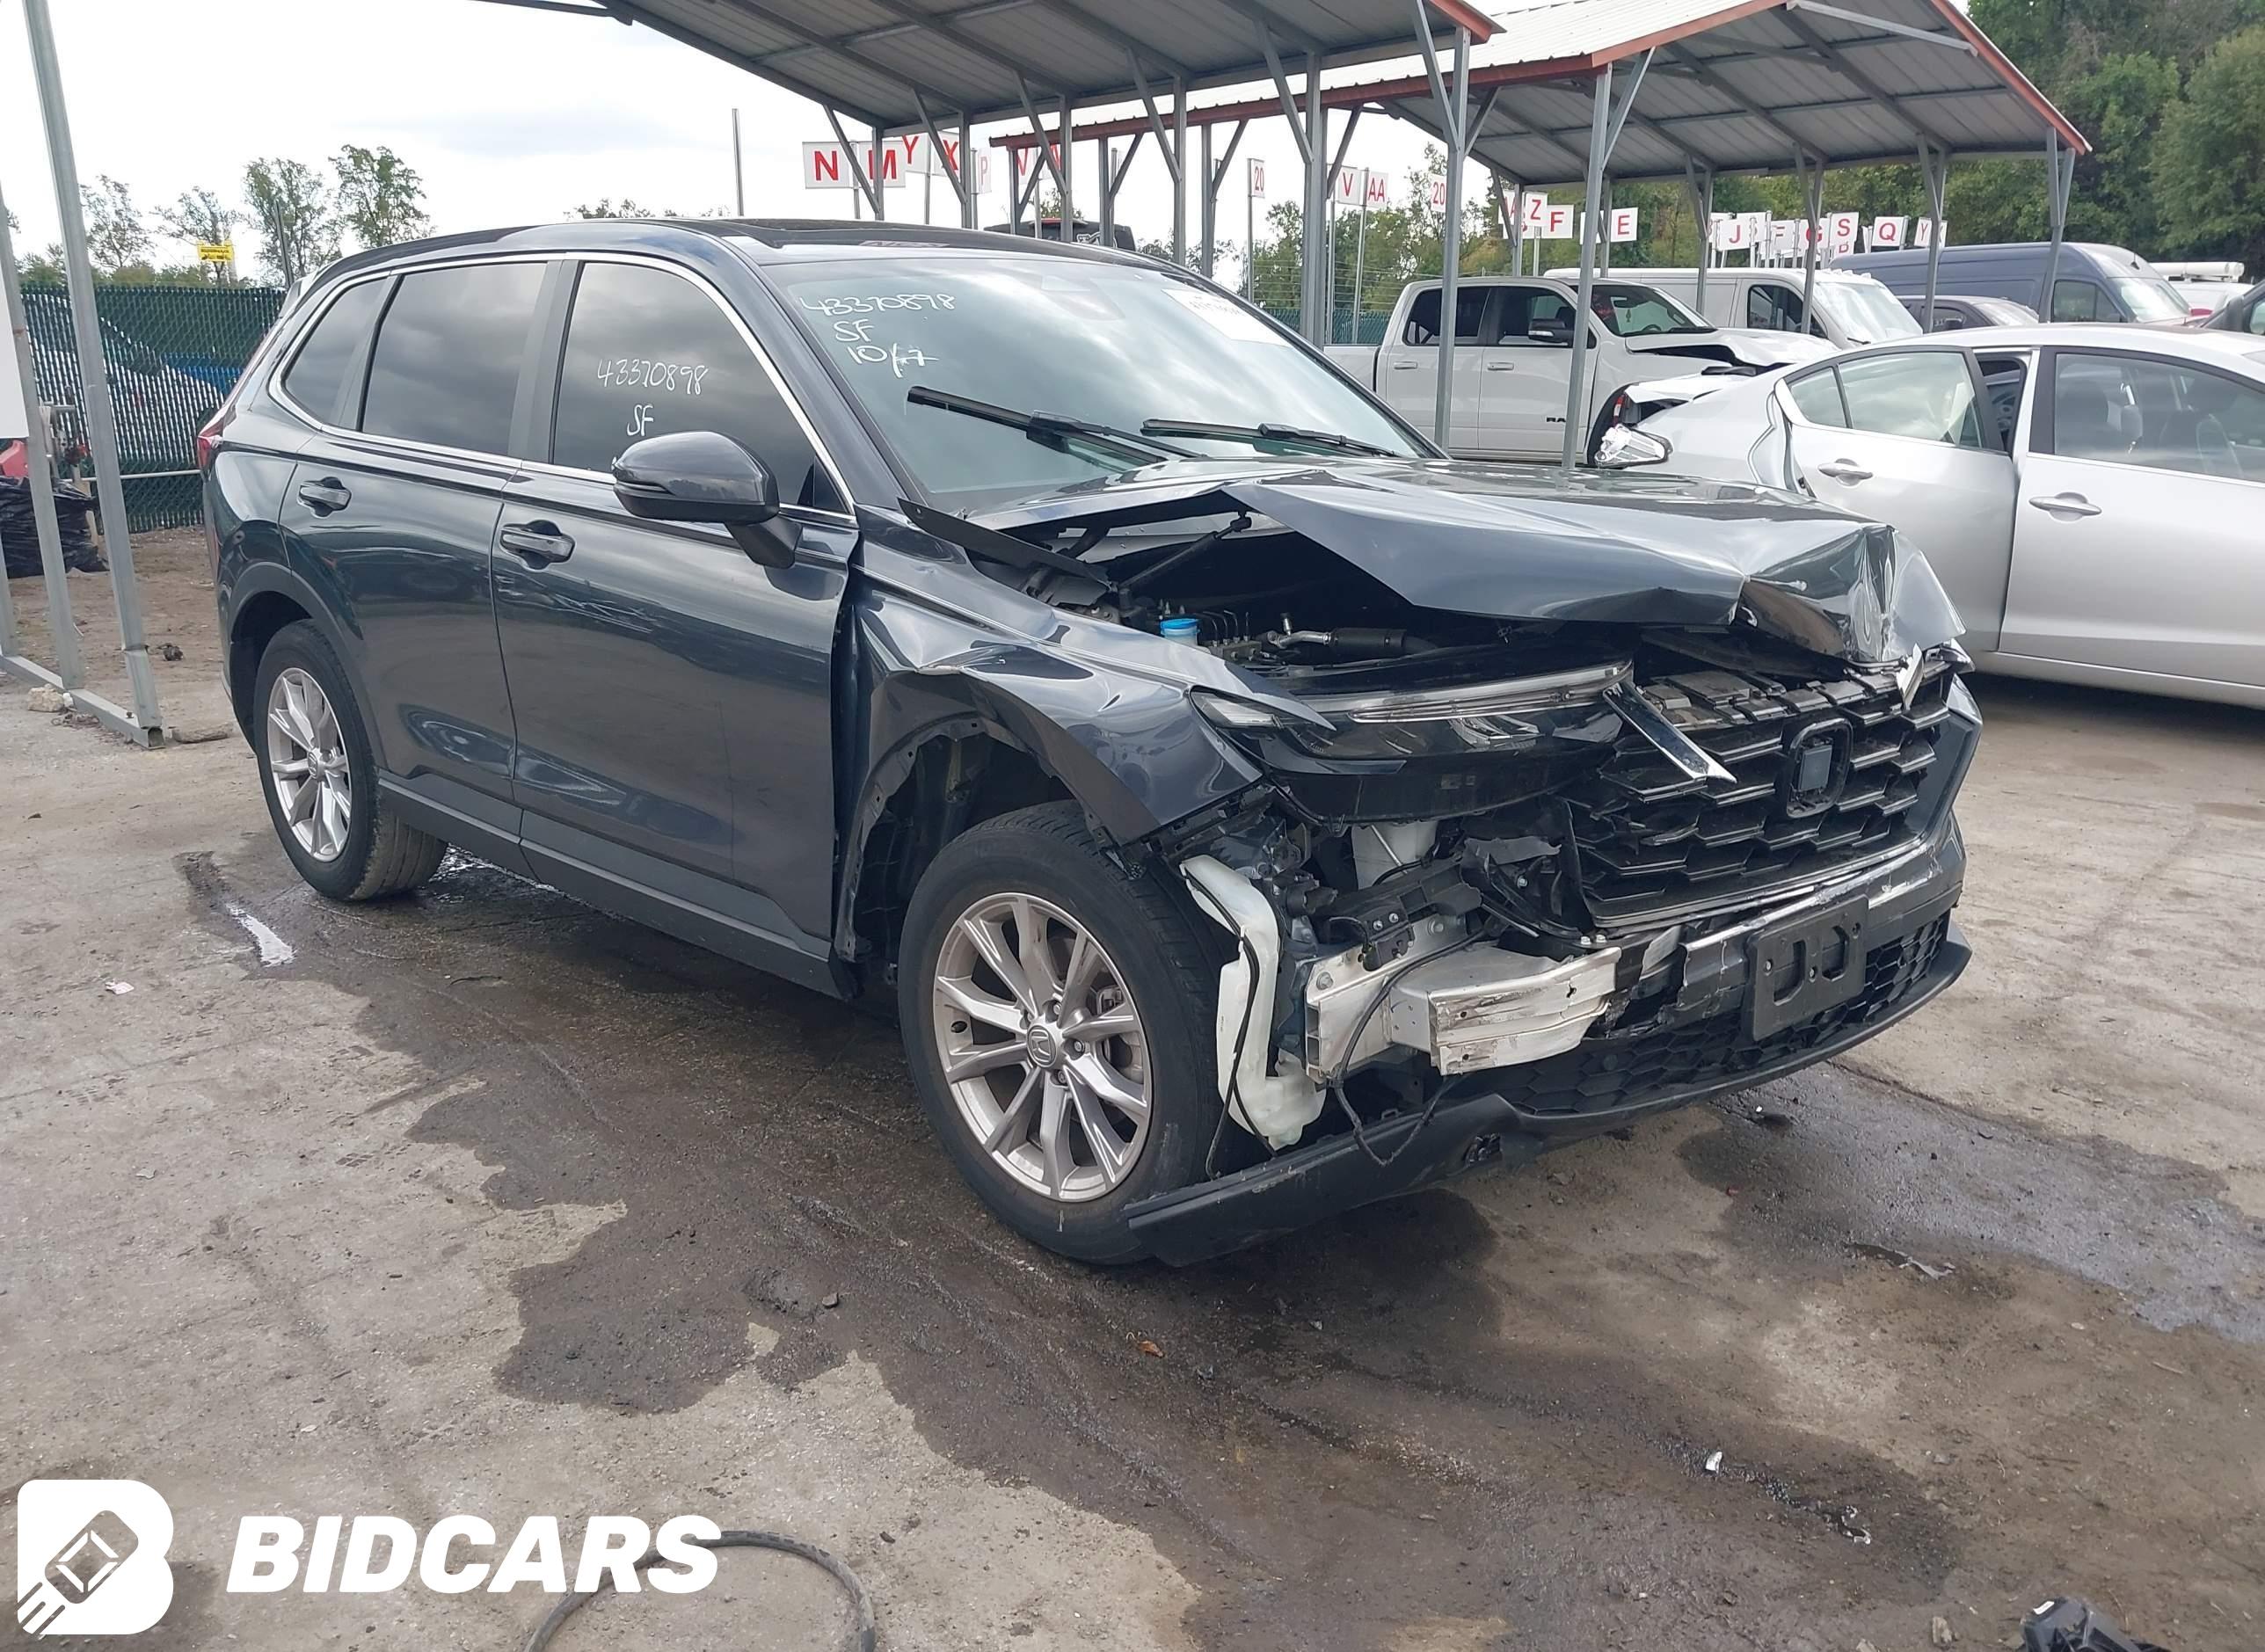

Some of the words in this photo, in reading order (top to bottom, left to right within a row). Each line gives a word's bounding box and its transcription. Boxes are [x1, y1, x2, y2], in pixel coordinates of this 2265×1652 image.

[902, 135, 919, 164] Y
[814, 150, 839, 181] N
[980, 156, 988, 186] P
[1254, 165, 1264, 192] 20
[1342, 171, 1354, 197] V
[1367, 178, 1386, 203] AA
[1432, 180, 1446, 206] 20
[1530, 199, 1542, 221] Z
[1550, 211, 1564, 232] F
[1617, 215, 1630, 236] E
[1729, 224, 1741, 244] J
[1837, 218, 1851, 237] S
[1879, 222, 1896, 241] Q
[1920, 222, 1928, 241] Y
[799, 294, 956, 317] 43370898
[834, 318, 875, 342] SF
[597, 358, 709, 395] 43370898
[626, 404, 654, 437] SF
